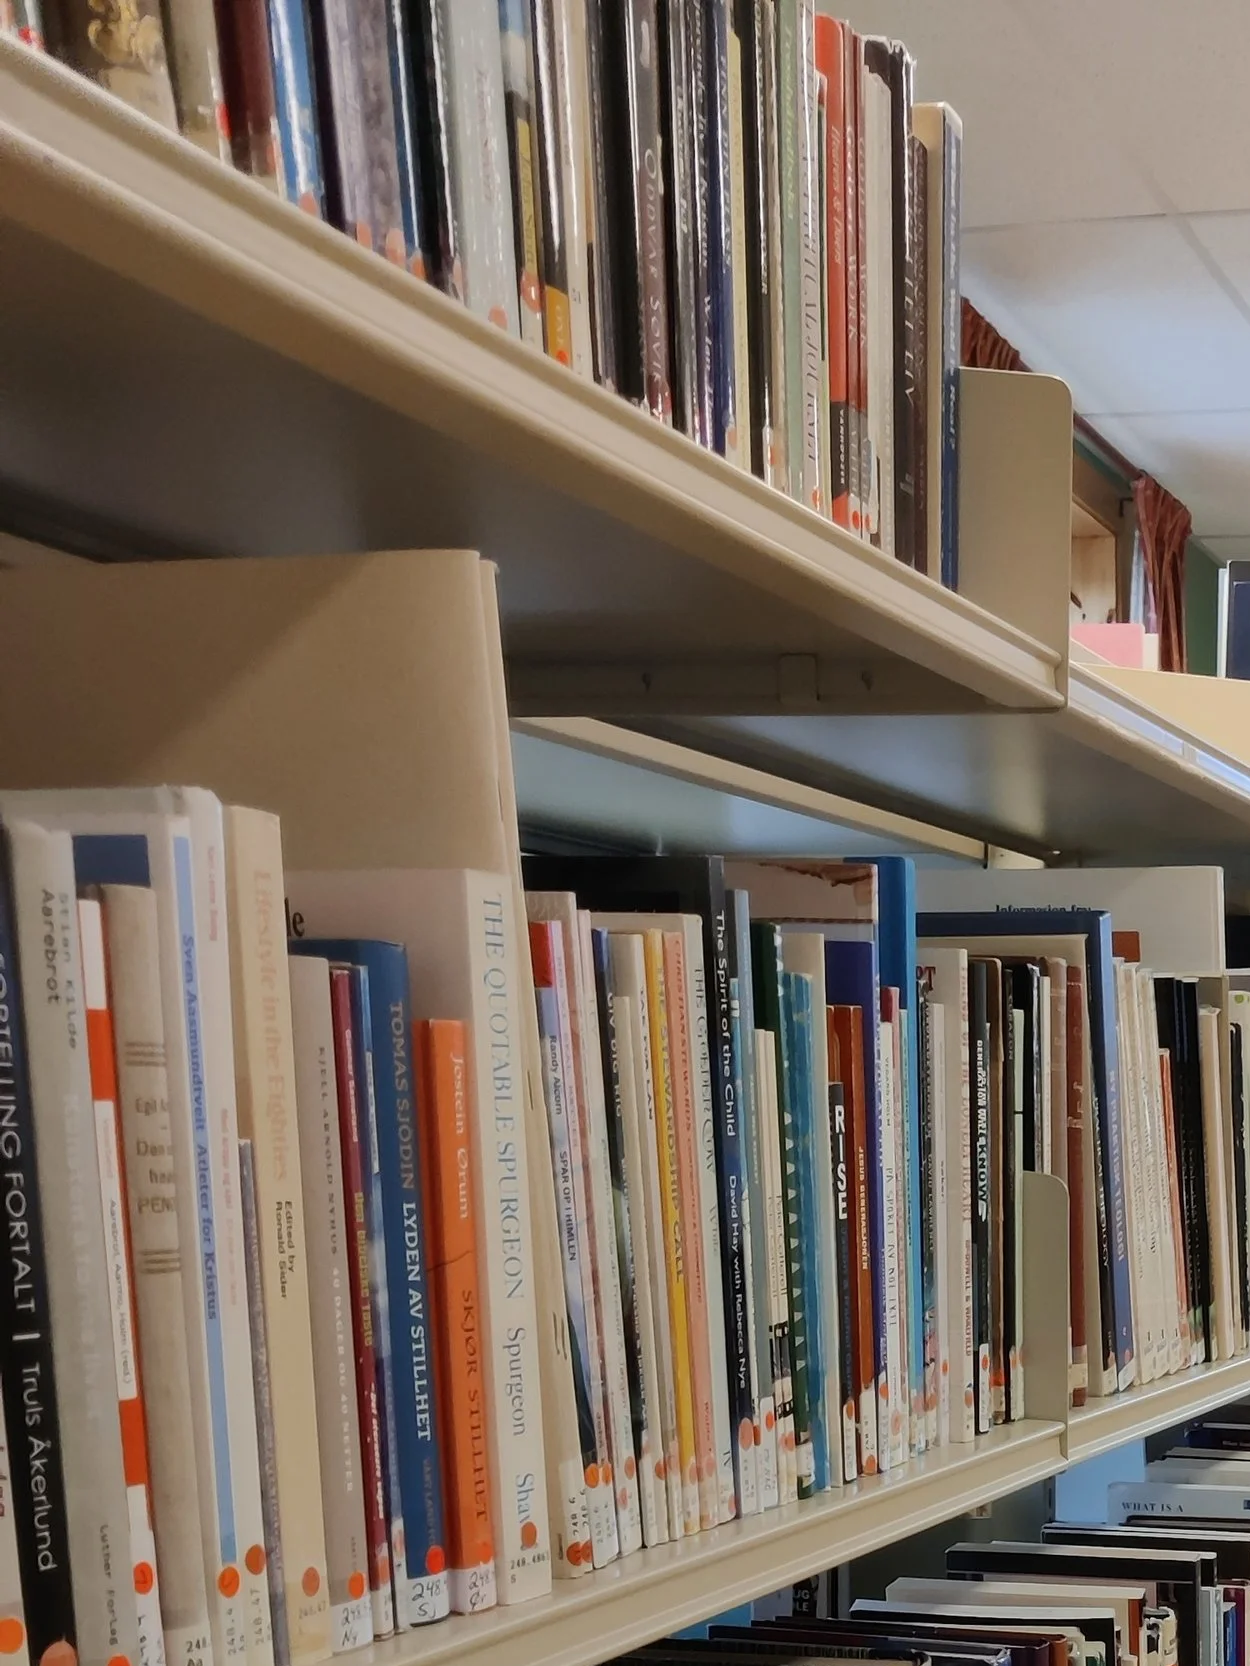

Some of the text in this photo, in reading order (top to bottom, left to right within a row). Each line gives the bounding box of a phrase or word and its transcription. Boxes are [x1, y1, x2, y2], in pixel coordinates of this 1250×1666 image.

[643, 148, 664, 386] ODDVAR SØVIK
[40, 889, 61, 1005] Aarebrot
[253, 870, 291, 1182] Lifestyle in the Eighties
[389, 1001, 409, 1092] TOMAS
[674, 940, 692, 1132] CHRISTIAN STEWARDS
[549, 1035, 564, 1115] Randy Alcorn
[661, 1026, 681, 1212] STEWARDSHIP
[182, 935, 220, 1320] Sven Aasmundtveit Atleter for Kristus
[482, 893, 531, 1436] THE QUOTABLE SPURGEON Spurgeon
[559, 1151, 571, 1184] SPAR
[716, 910, 748, 1390] The Spirit of the Child David Hay with Rebecca Nye
[1108, 1100, 1123, 1187] PRAKTISK
[282, 1201, 296, 1273] Edited by
[561, 1187, 571, 1204] OP
[564, 1213, 578, 1261] HIMLEN
[961, 1166, 971, 1224] HEART
[1112, 1193, 1127, 1261] TEOLOGI
[5, 1172, 36, 1312] FORTALT
[274, 1201, 289, 1300] Ronald Sider
[402, 1202, 421, 1283] LYDEN
[408, 1288, 424, 1319] AV
[449, 1054, 488, 1522] Jostein Ørum SKJØR STILLHET
[410, 1326, 431, 1441] STILLHET
[22, 1363, 59, 1573] Truls Åkerlund
[342, 1422, 354, 1493] NETTER
[99, 1524, 115, 1578] Luther
[1121, 1501, 1184, 1513] WHAT IS A
